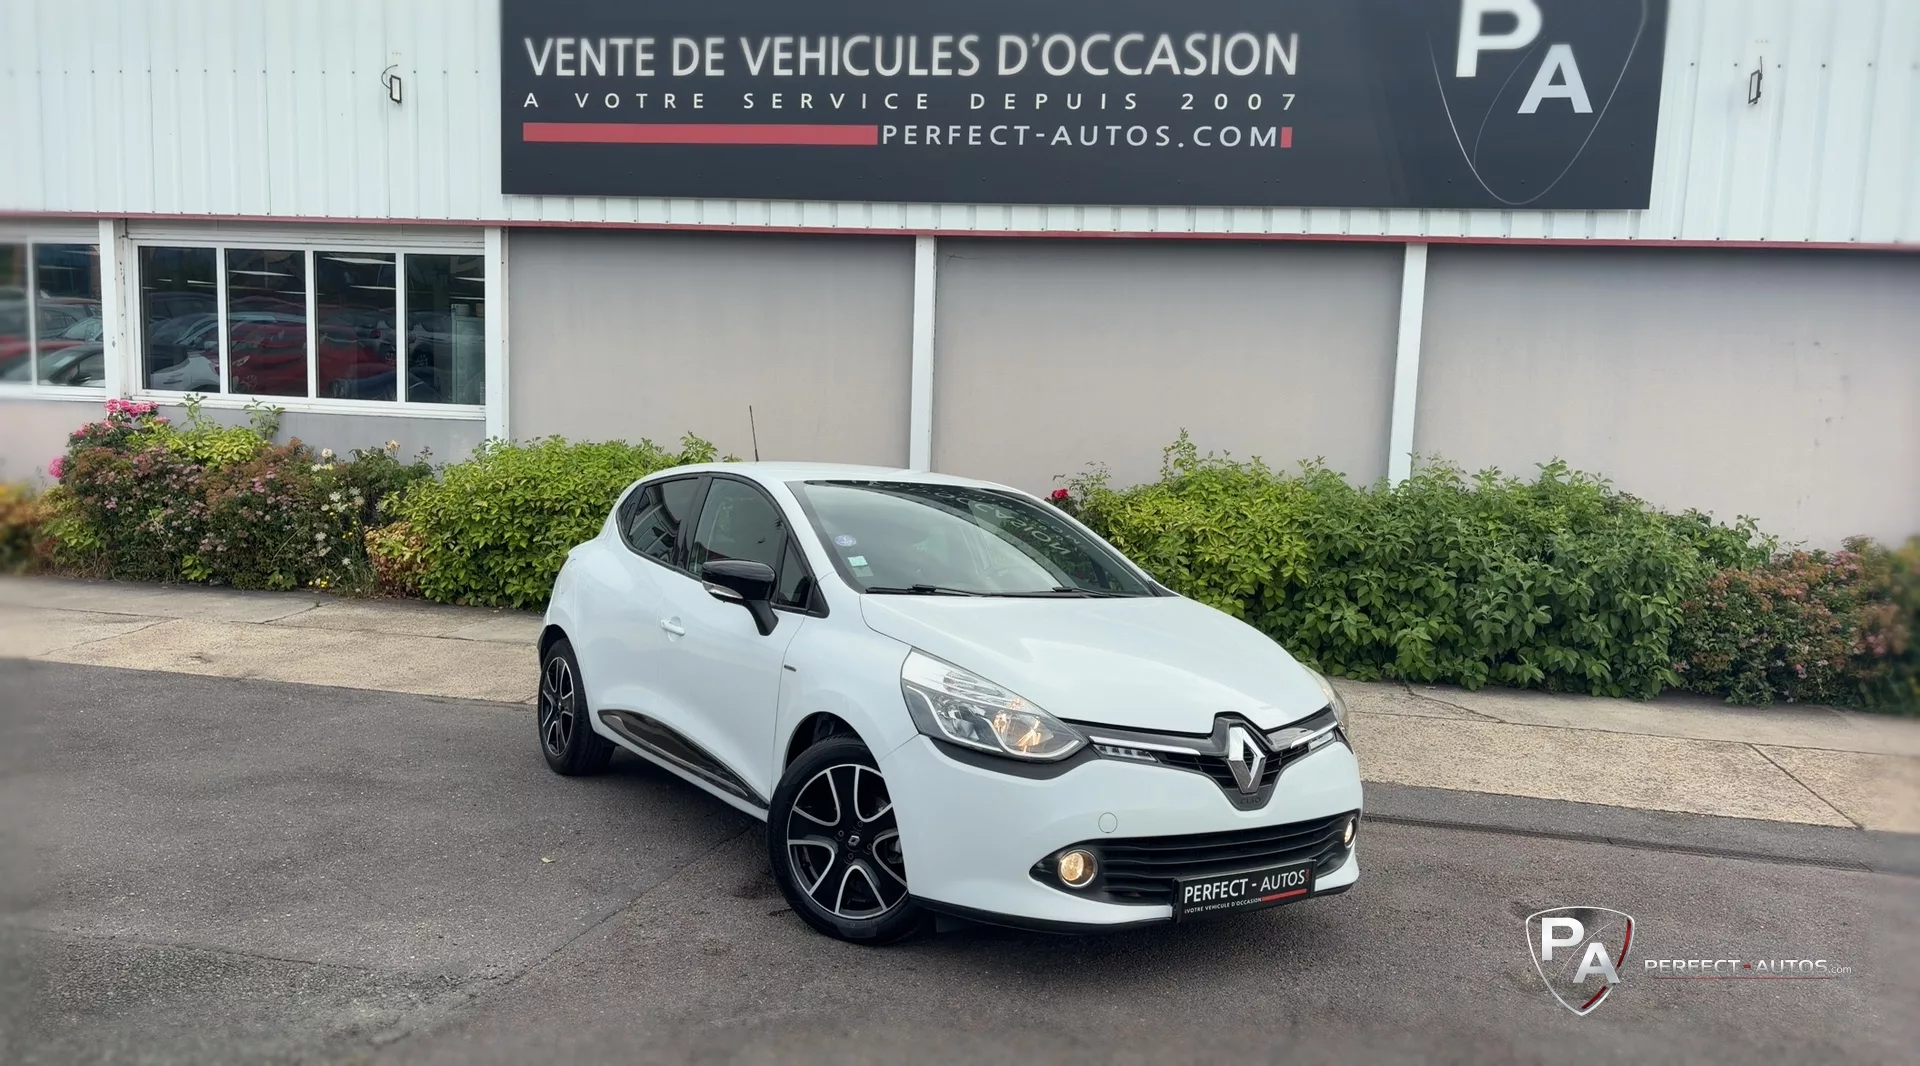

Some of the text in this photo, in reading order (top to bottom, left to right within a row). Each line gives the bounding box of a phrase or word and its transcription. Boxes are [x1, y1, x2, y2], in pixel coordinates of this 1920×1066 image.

[524, 32, 1298, 77] VENTE DE VEHICULES D'OCCASION
[523, 92, 1296, 111] A VOTRE SERVICE DEPUIS 2007
[882, 124, 1277, 148] PERFECT-AUTOS.COM
[1184, 878, 1249, 903] PERFECT
[1260, 869, 1305, 892] AUTOS
